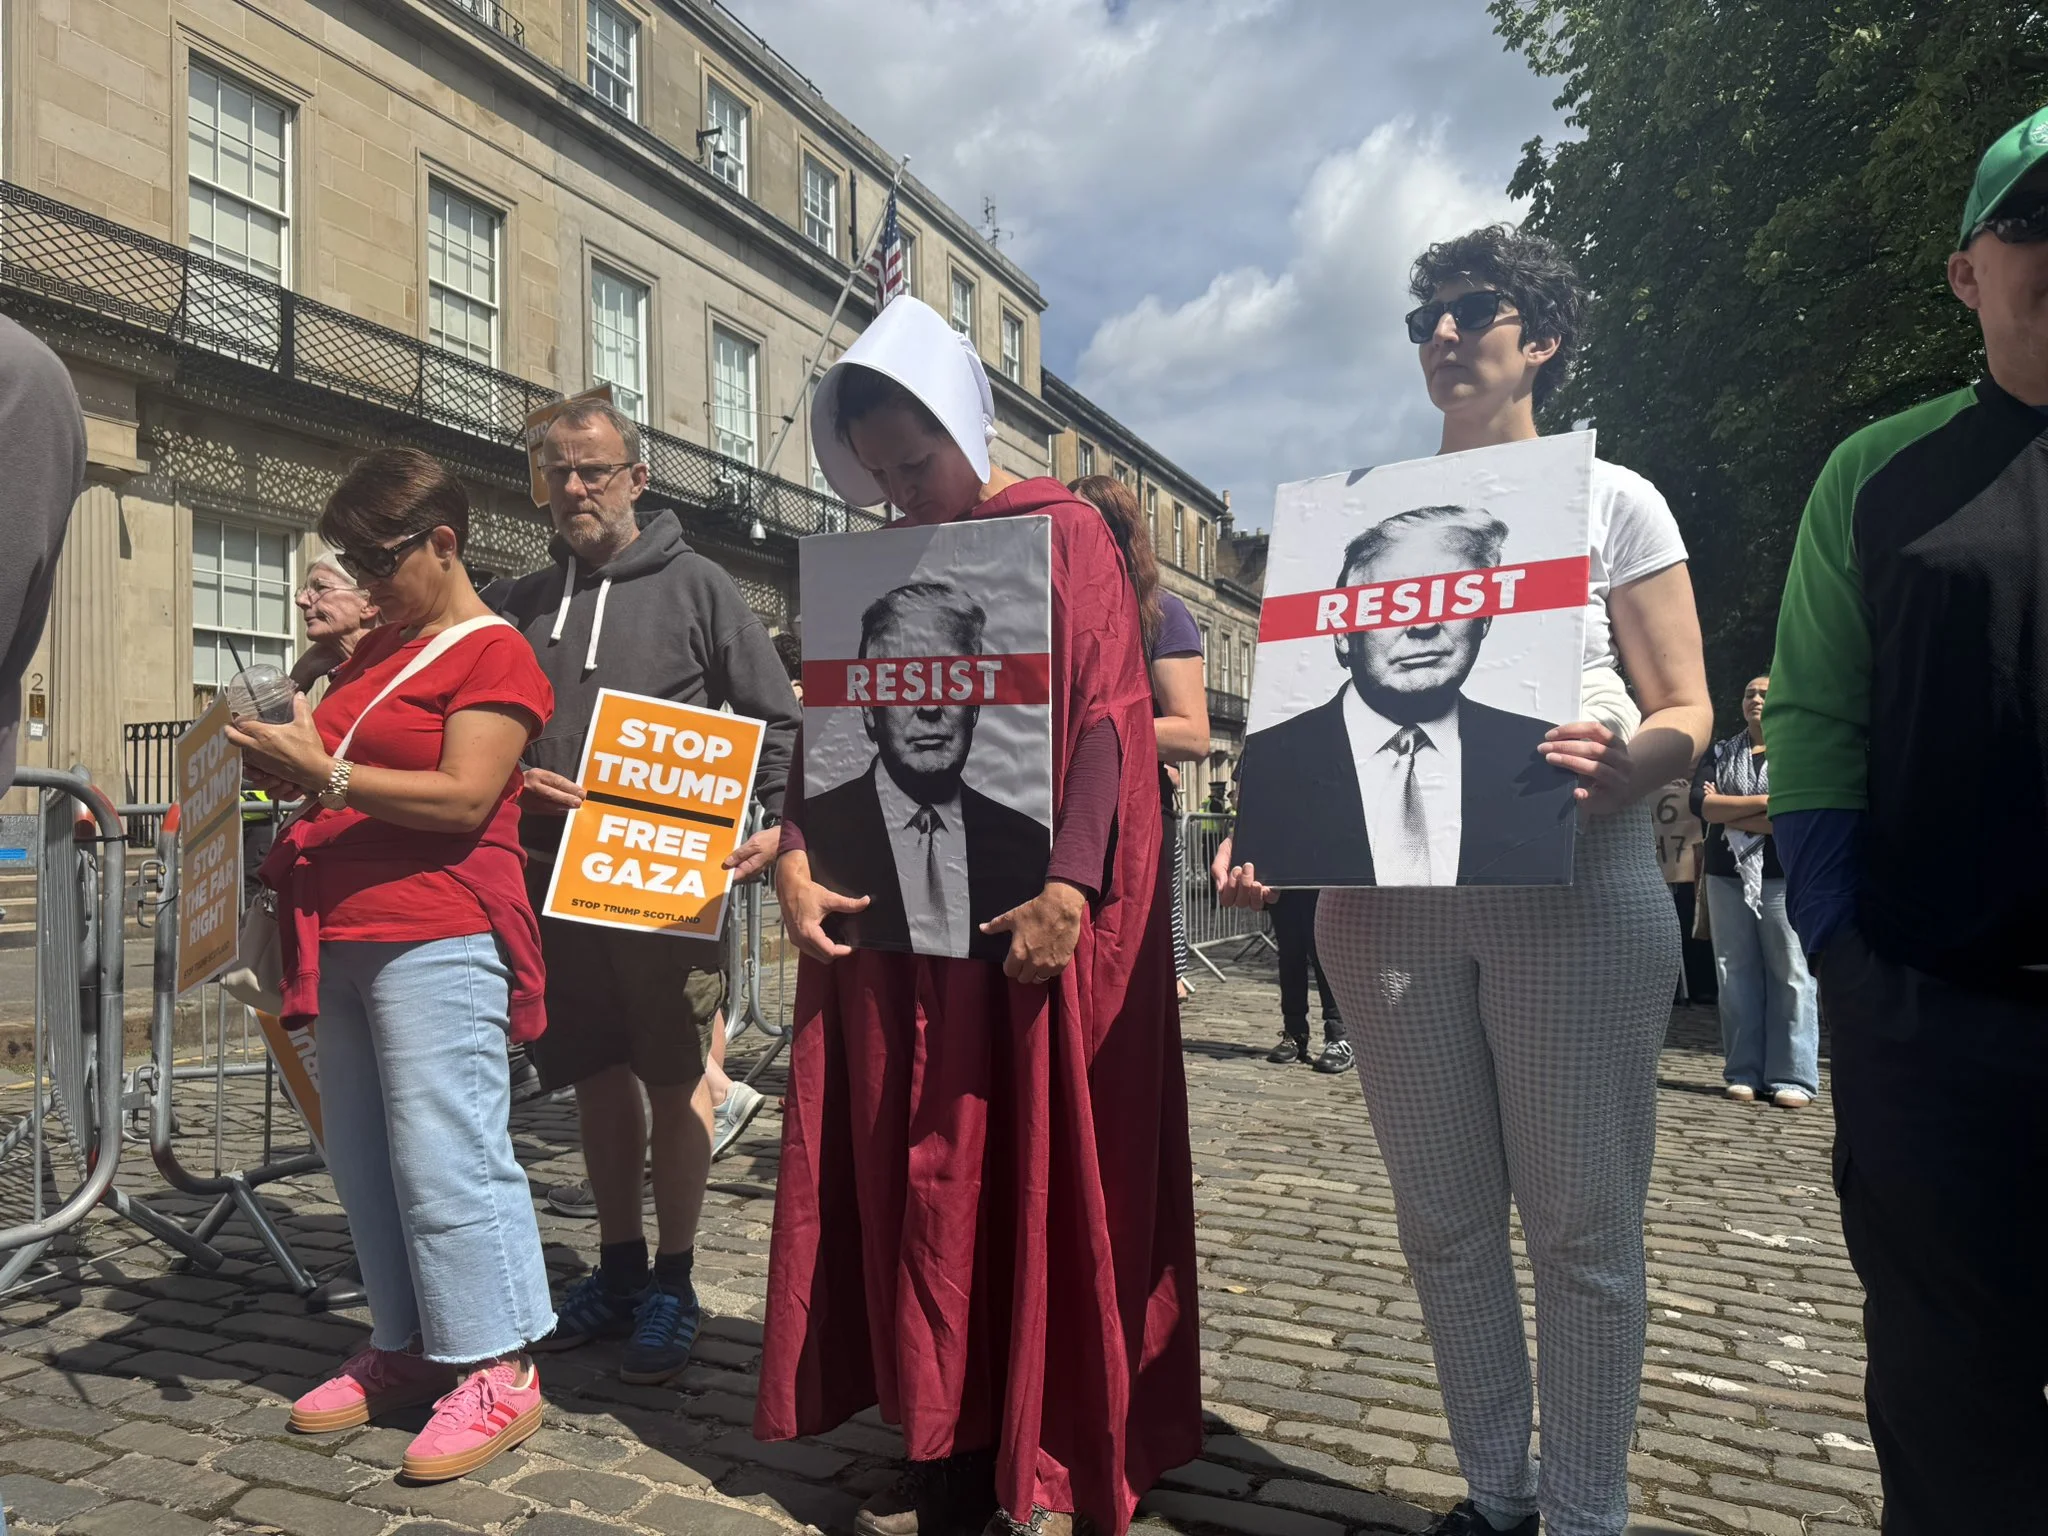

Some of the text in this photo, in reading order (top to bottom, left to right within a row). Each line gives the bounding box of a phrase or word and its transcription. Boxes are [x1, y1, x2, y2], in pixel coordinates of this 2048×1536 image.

[1315, 568, 1526, 631] RESIST
[31, 673, 44, 691] 2
[846, 660, 1002, 701] RESIST
[187, 726, 229, 789] STOP
[617, 717, 733, 764] STOP
[183, 757, 238, 833] TRUMP
[593, 751, 743, 806] TRUMP
[192, 833, 226, 881] STOP
[597, 814, 711, 862] FREE
[185, 858, 234, 918] THE FAR
[581, 852, 706, 898] GAZA
[189, 896, 227, 947] RIGHT
[571, 898, 701, 924] STOP TRUMP SCOTLAND
